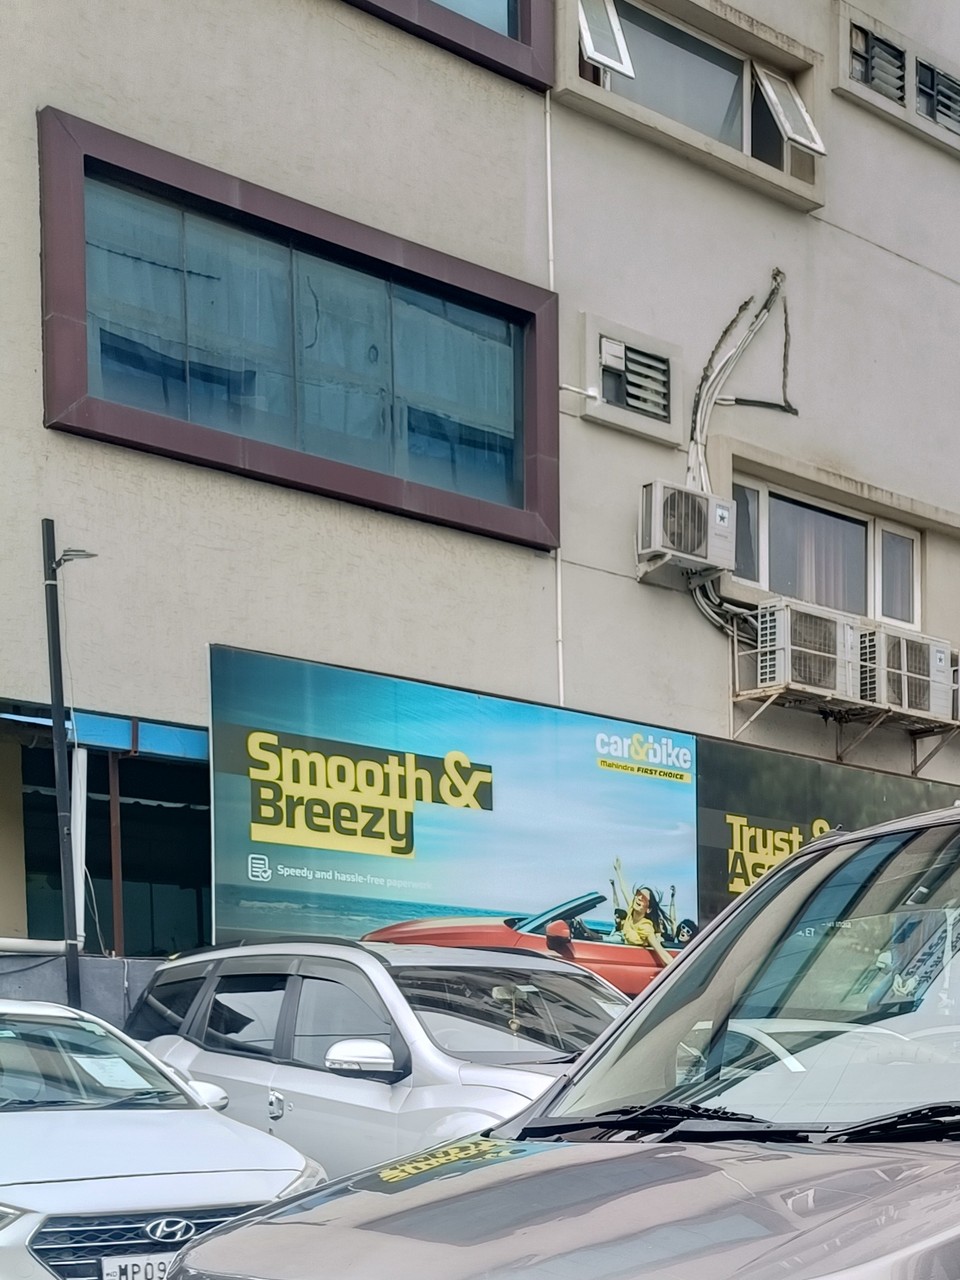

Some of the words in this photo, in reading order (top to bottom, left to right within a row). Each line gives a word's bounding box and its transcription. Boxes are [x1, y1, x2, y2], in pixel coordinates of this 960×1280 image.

[248, 731, 433, 803] Smooth
[439, 750, 492, 810] &
[595, 733, 691, 769] car&bike
[600, 760, 635, 772] Mahindra
[637, 766, 658, 776] FIRST
[658, 770, 684, 780] CHOICE
[251, 781, 414, 855] Breezy
[725, 814, 803, 857] Trust
[277, 865, 313, 879] Speedy
[315, 869, 332, 880] and
[335, 871, 385, 886] hassle-free
